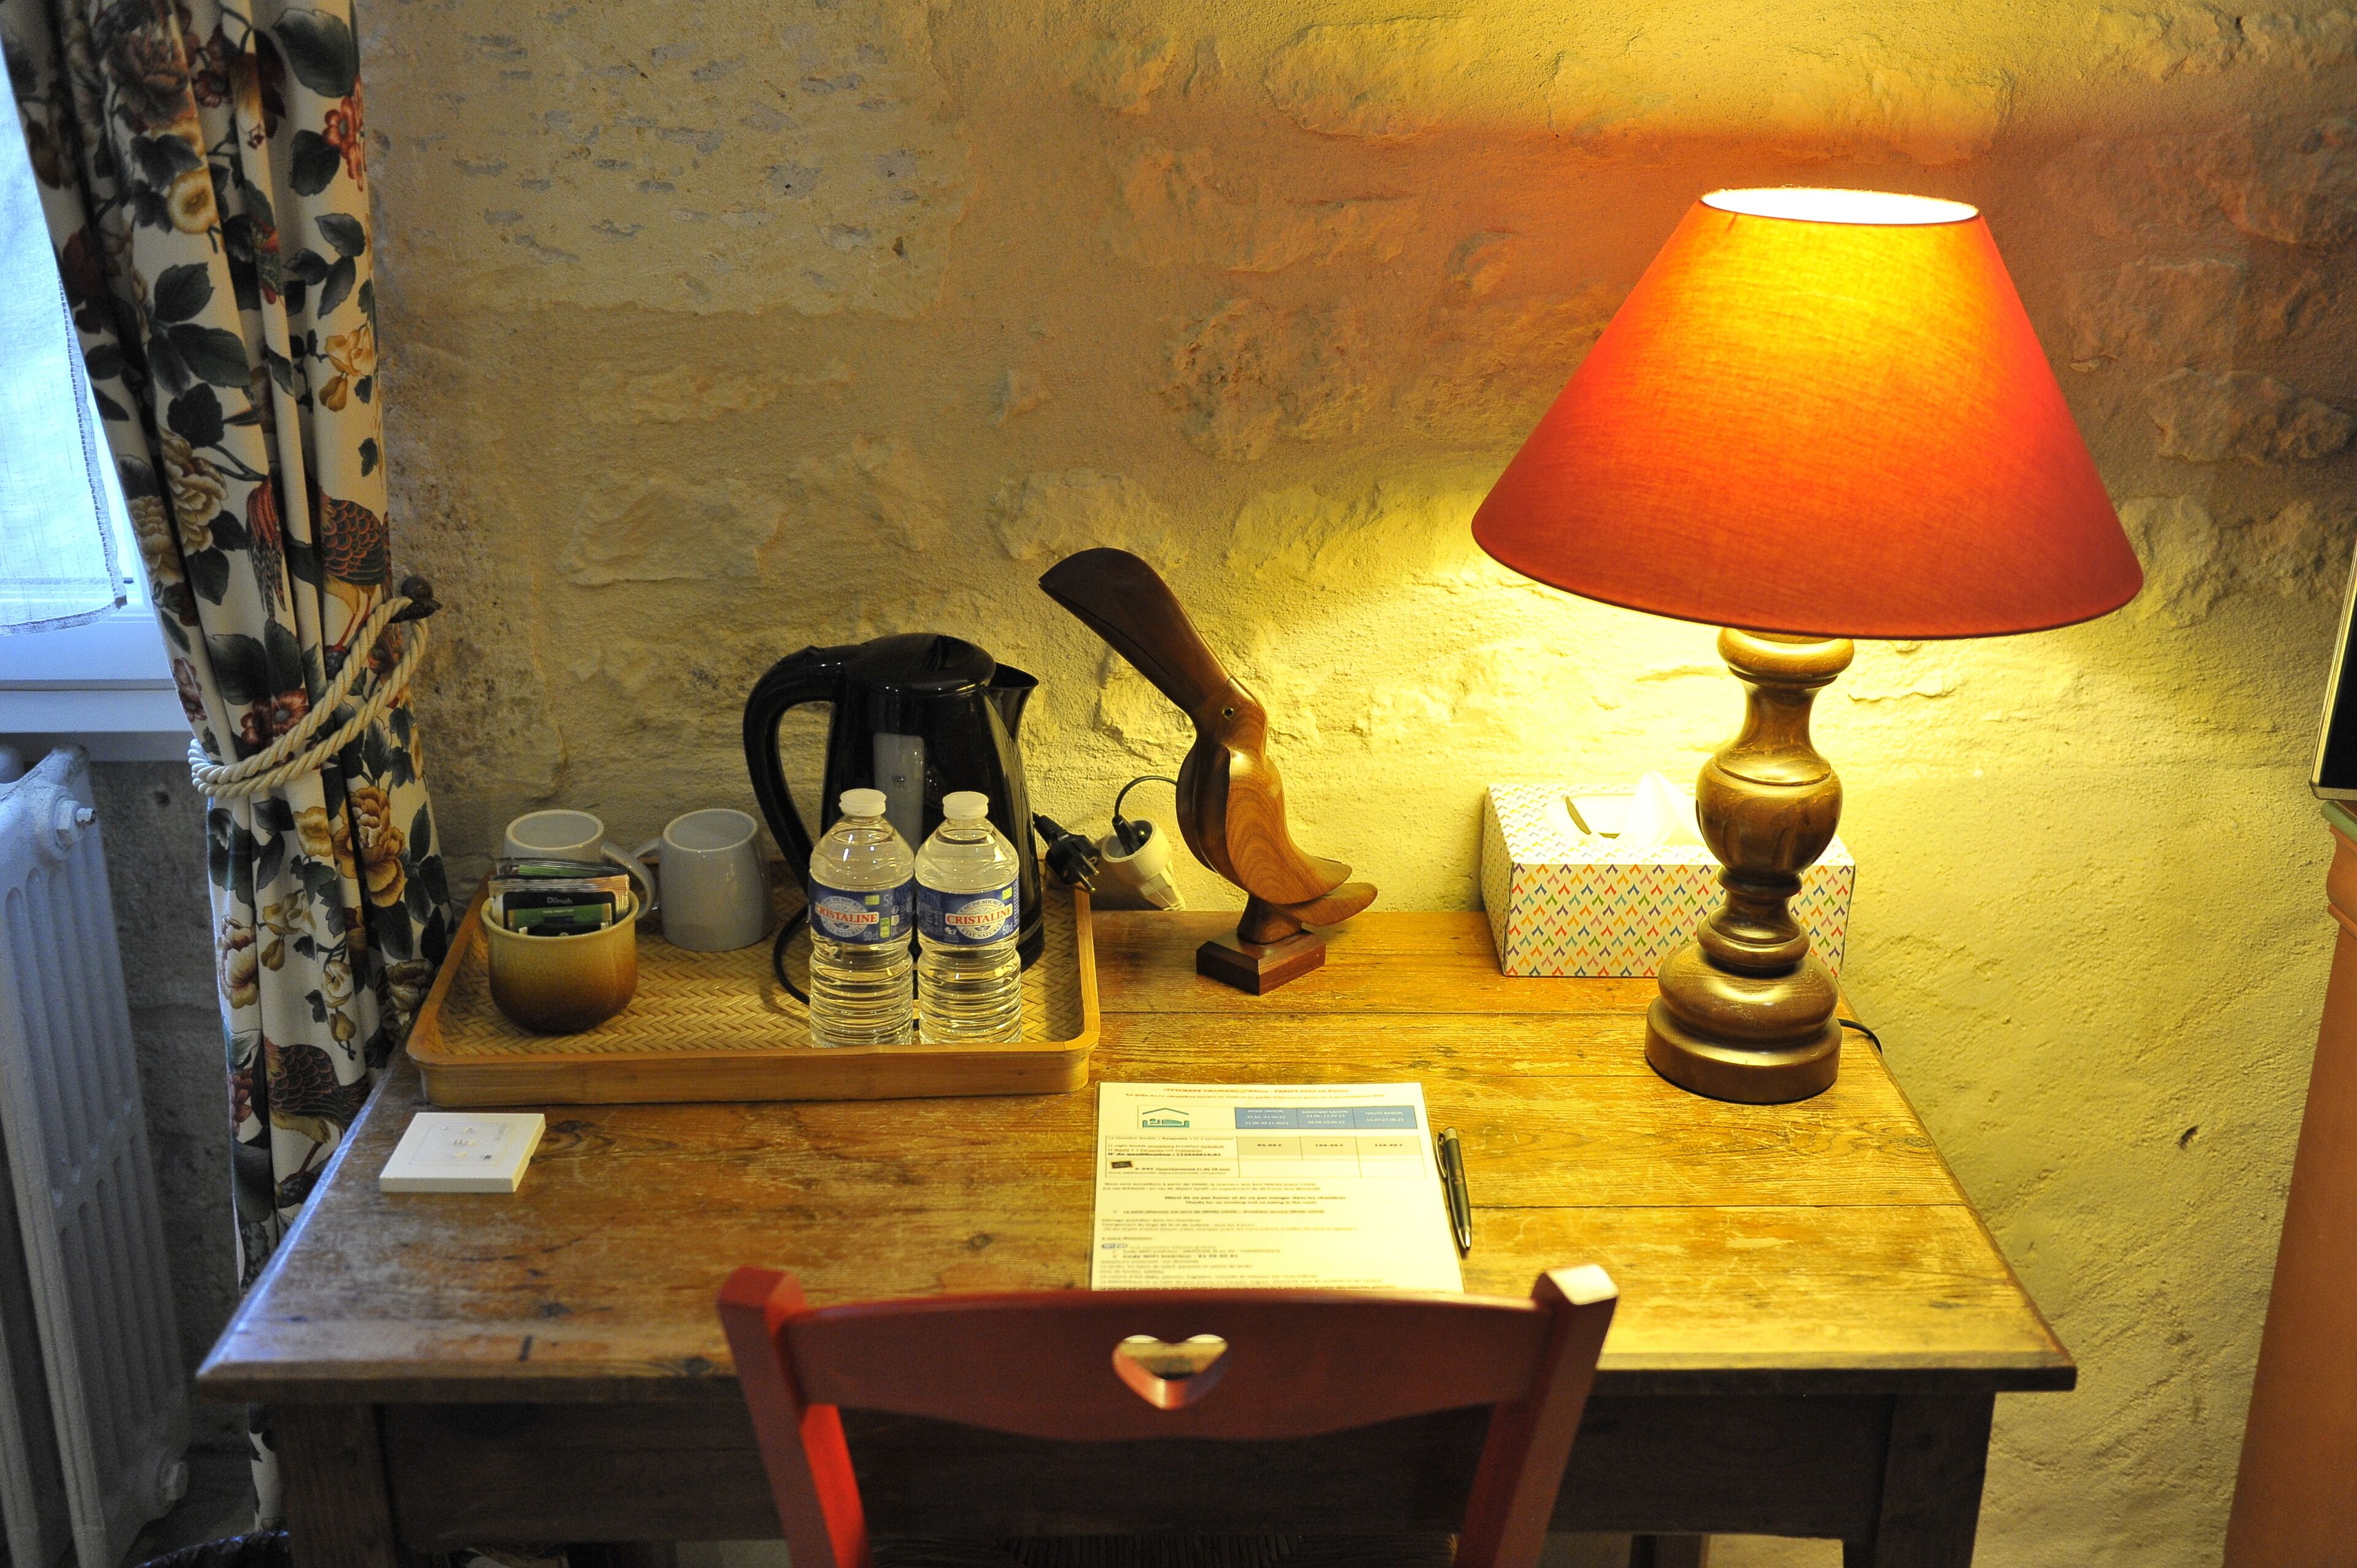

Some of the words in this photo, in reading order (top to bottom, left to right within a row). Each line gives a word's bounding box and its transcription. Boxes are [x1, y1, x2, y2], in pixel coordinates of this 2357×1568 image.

[818, 906, 877, 923] RISTALINE
[946, 905, 1012, 925] CRISTALINE
[864, 931, 879, 941] 50cl
